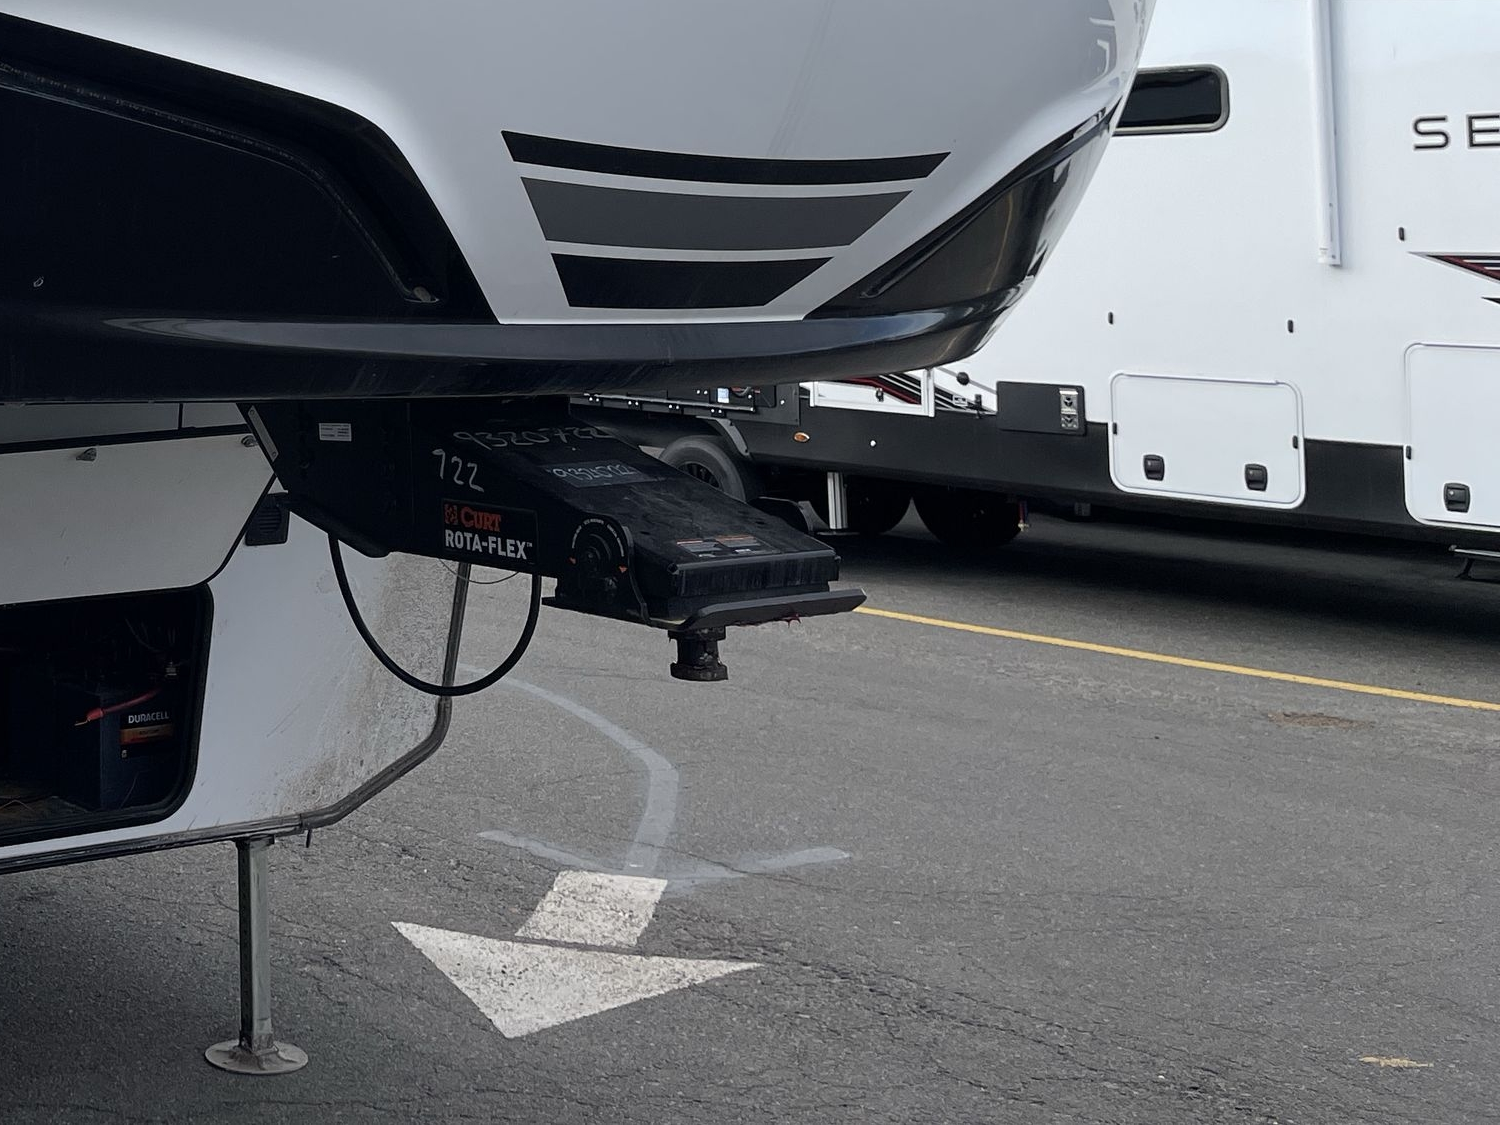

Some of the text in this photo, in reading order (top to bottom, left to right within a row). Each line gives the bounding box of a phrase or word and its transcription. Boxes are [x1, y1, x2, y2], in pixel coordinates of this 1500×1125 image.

[1412, 113, 1500, 150] SE
[460, 506, 501, 532] CURT
[128, 711, 170, 724] DURACELL
